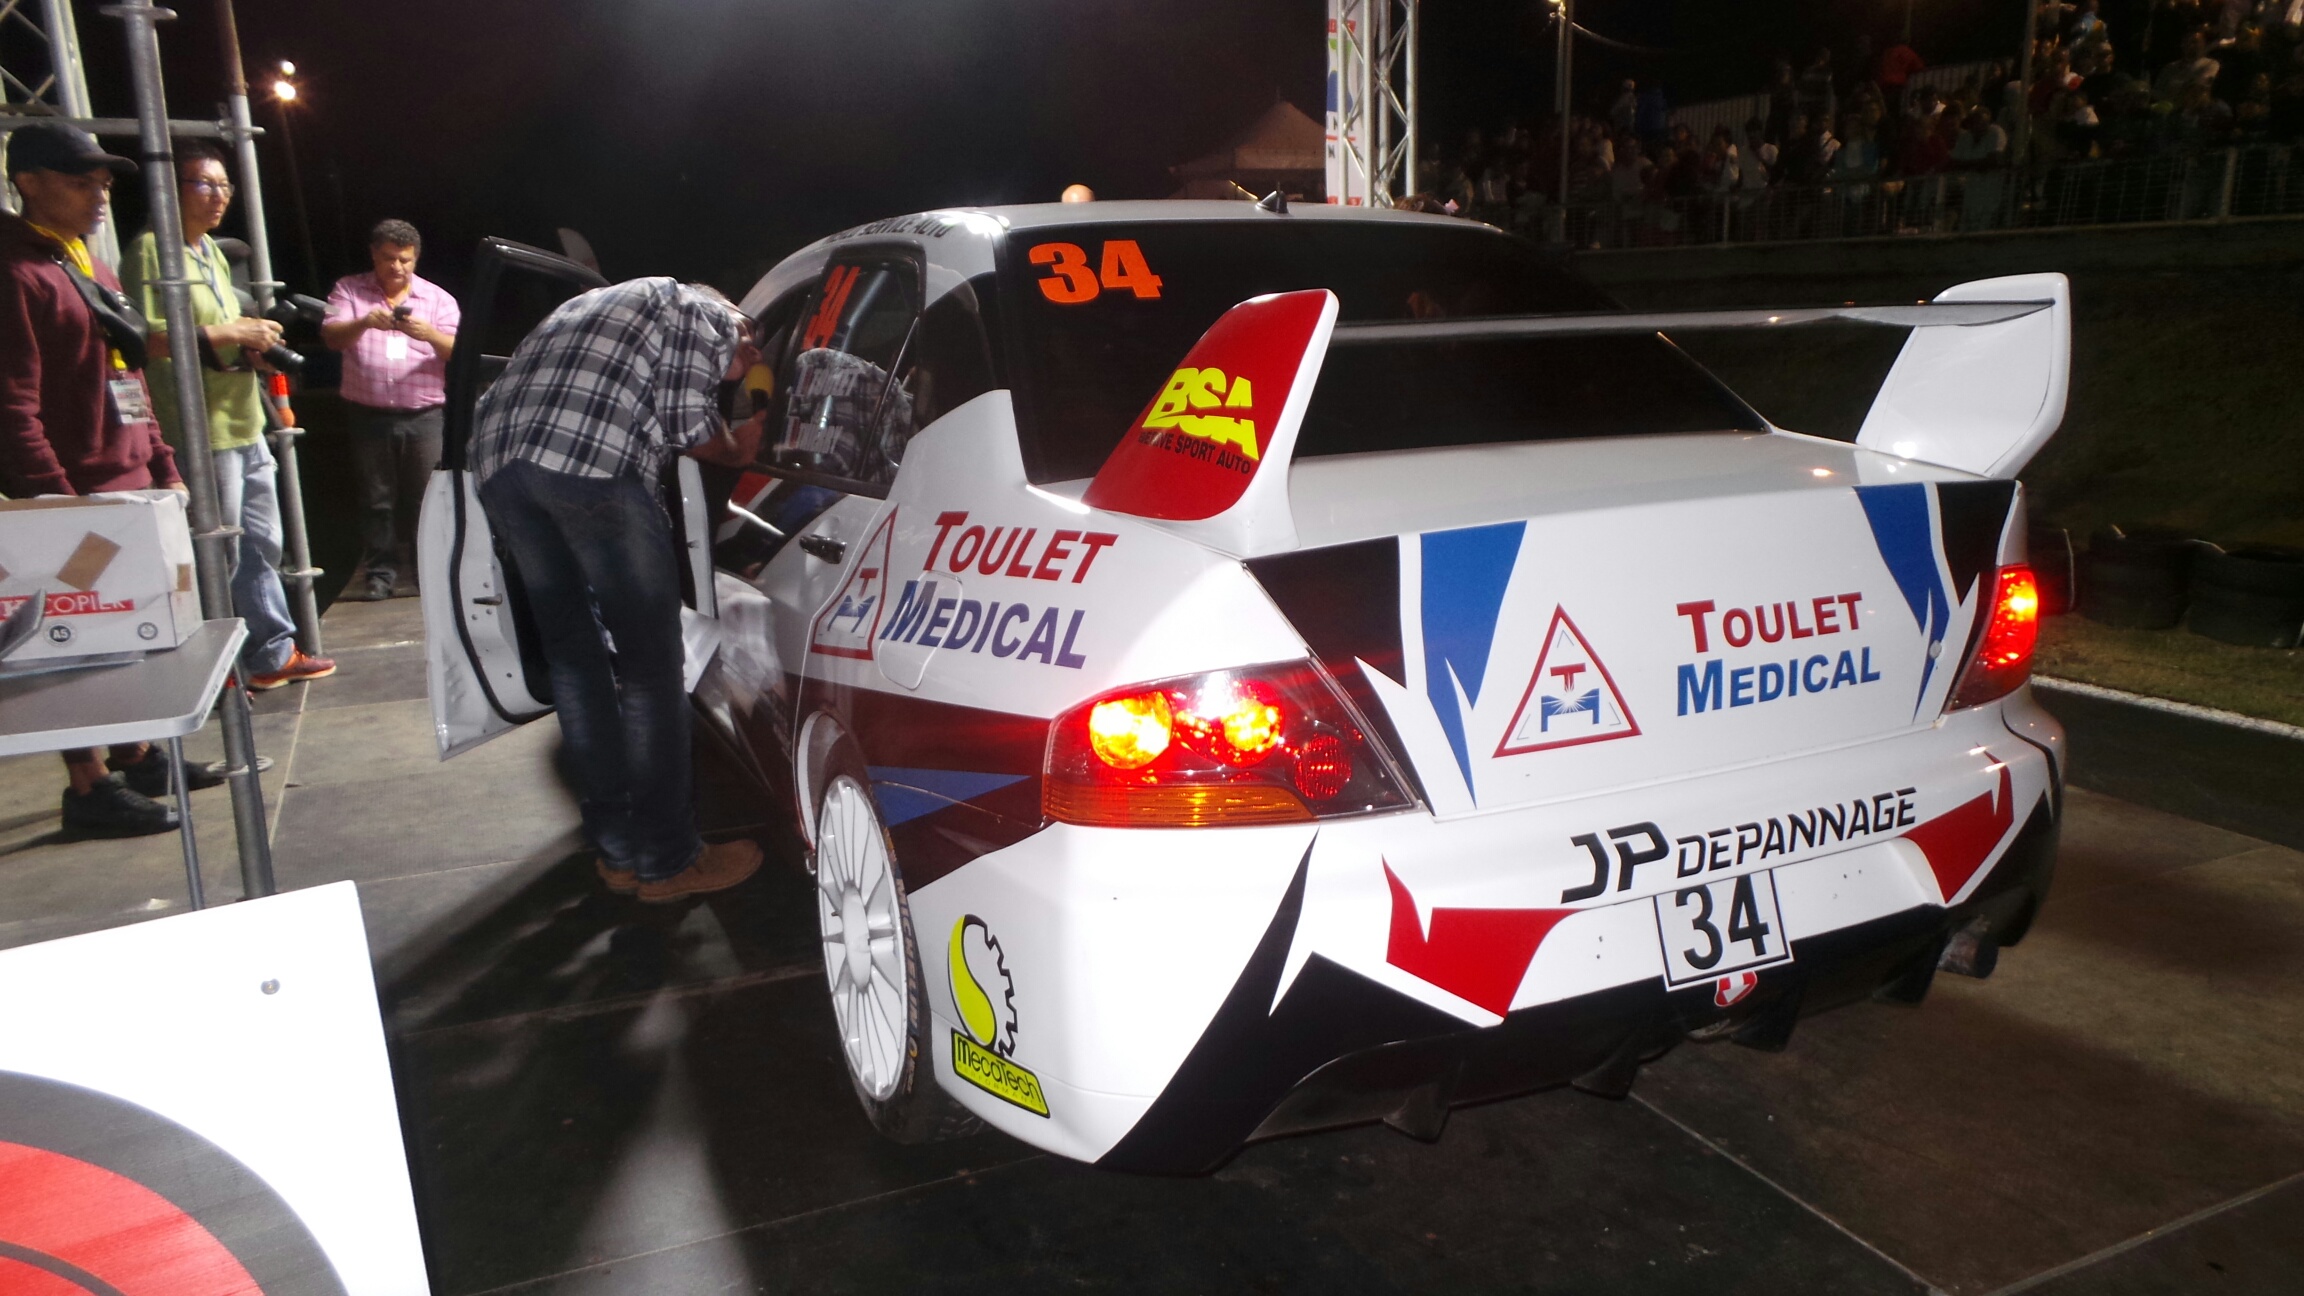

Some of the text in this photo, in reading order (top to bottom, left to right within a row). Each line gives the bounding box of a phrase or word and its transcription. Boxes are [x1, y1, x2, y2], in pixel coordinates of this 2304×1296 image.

[803, 265, 861, 350] 34
[1028, 240, 1163, 303] 34
[1142, 367, 1259, 460] BSA
[1175, 436, 1216, 462] SPORT
[1216, 450, 1251, 474] AUTO
[923, 511, 1119, 583] TOULET
[879, 580, 1087, 669] MEDICAL
[1676, 592, 1863, 654] TOULET
[1676, 646, 1881, 717] MEDICAL
[1561, 786, 1917, 904] JP DEPANNAGE
[895, 878, 919, 1031] MICHELIN
[1675, 872, 1771, 970] 34
